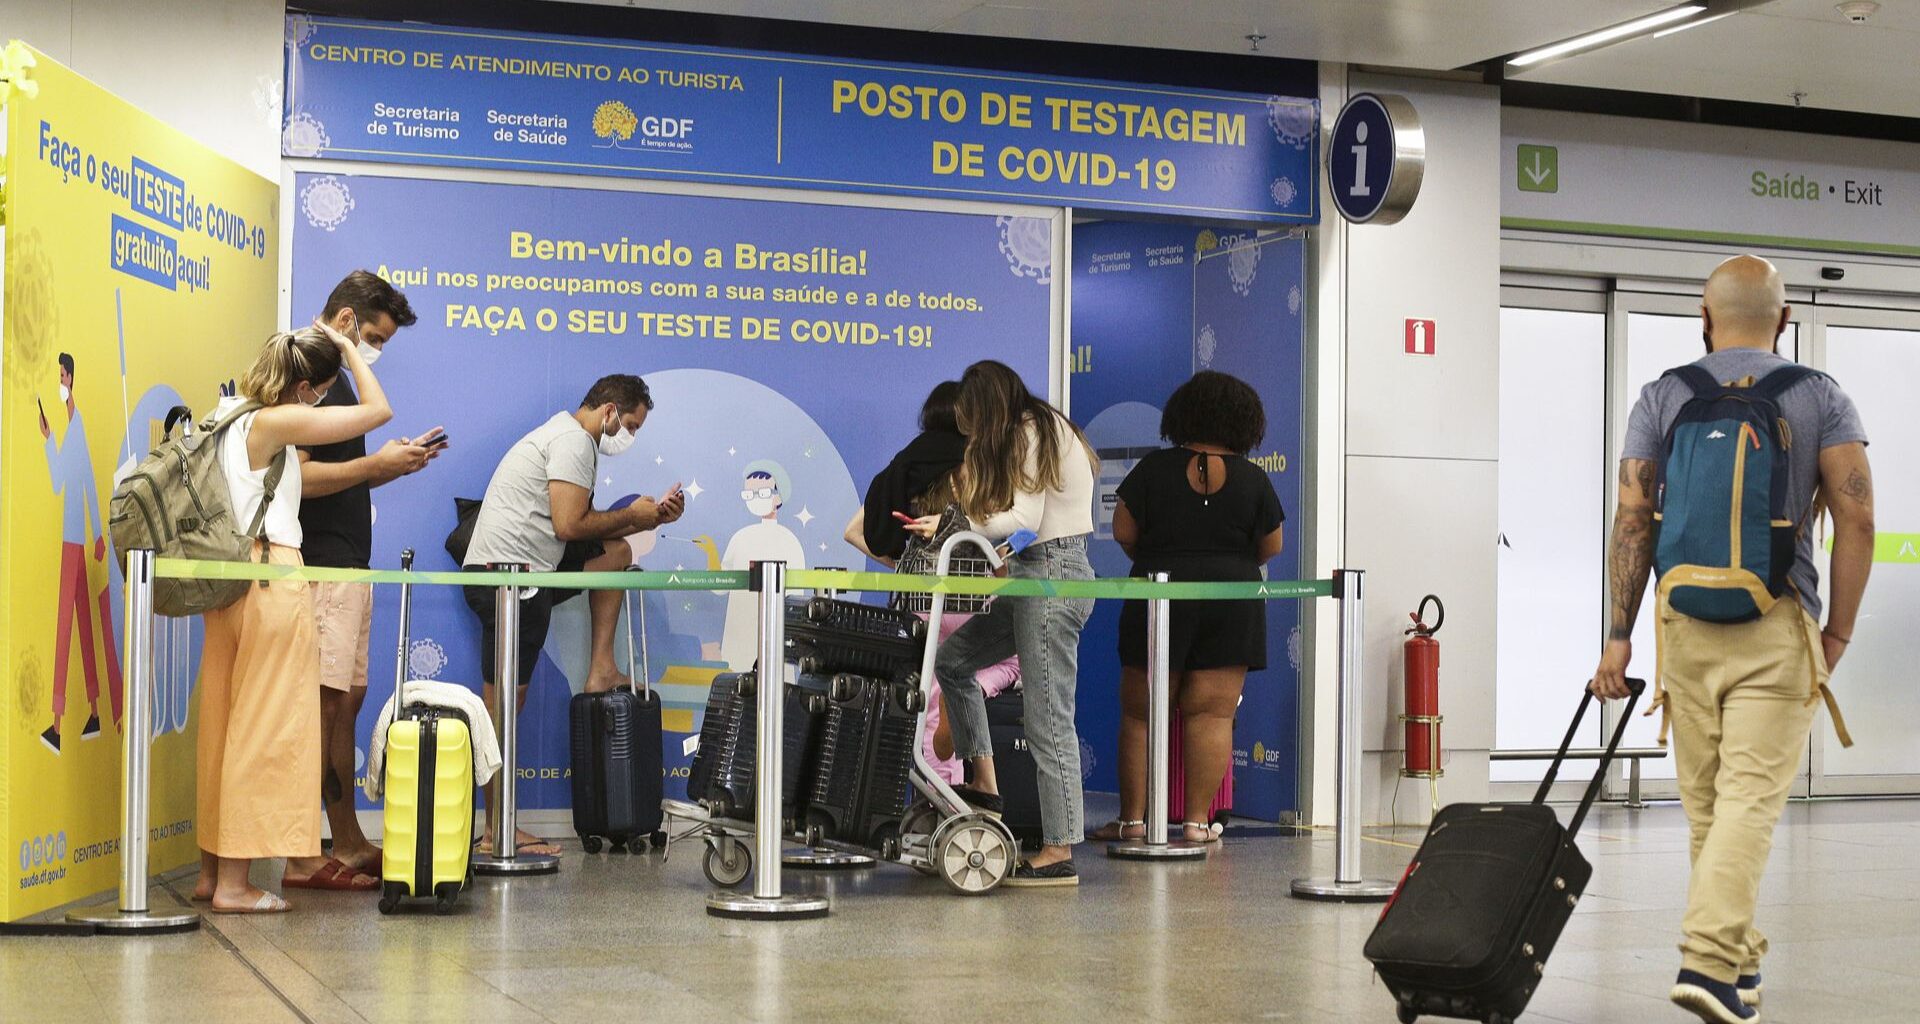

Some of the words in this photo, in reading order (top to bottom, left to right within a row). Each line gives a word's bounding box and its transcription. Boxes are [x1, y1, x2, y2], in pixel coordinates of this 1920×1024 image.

[310, 43, 406, 66] CENTRO
[414, 51, 442, 69] DE
[450, 54, 612, 82] ATENDIMENTO
[618, 67, 650, 84] AO
[656, 69, 744, 91] TURISTA
[374, 103, 460, 122] Secretaria
[487, 110, 568, 129] Secretaria
[832, 79, 968, 124] POSTO
[981, 92, 1033, 130] DE
[1044, 97, 1246, 147] TESTAGEM
[367, 120, 389, 136] de
[392, 121, 460, 140] Turismo
[493, 126, 514, 143] de
[517, 126, 567, 146] Saúde
[641, 116, 694, 139] GDF
[647, 140, 666, 148] tempo
[932, 141, 985, 177] DE
[998, 146, 1177, 192] COVID-19
[39, 119, 81, 184] Faça
[87, 154, 96, 184] o
[101, 161, 129, 200] seu
[134, 165, 182, 225] TESTE
[187, 194, 203, 232] de
[206, 202, 265, 260] COVID-19
[1751, 170, 1820, 201] Saída
[1845, 180, 1882, 206] Exit
[115, 228, 174, 278] gratuito
[178, 254, 210, 294] aqui!
[509, 231, 694, 268] Bem-vindo
[704, 247, 723, 269] a
[735, 243, 868, 277] Brasília!
[1092, 250, 1131, 264] Secretaria
[1146, 244, 1184, 257] Secretaria
[1089, 265, 1098, 275] de
[1101, 262, 1131, 274] Turismo
[1148, 257, 1158, 267] de
[376, 264, 429, 289] Aqui
[436, 270, 478, 287] nos
[486, 270, 643, 296] preocupamos
[650, 280, 698, 298] com
[705, 284, 718, 299] a
[725, 285, 765, 301] sua
[772, 284, 838, 305] saúde
[846, 291, 858, 306] e
[865, 292, 878, 307] a
[885, 290, 911, 308] de
[918, 292, 984, 312] todos.
[445, 304, 526, 336] FAÇA
[536, 308, 558, 332] O
[568, 309, 627, 335] SEU
[637, 312, 731, 339] TESTE
[741, 317, 781, 341] DE
[790, 319, 933, 348] COVID-19!
[1265, 749, 1280, 762] GDF
[540, 768, 559, 779] DE
[670, 767, 691, 778] AO
[73, 842, 102, 864] CENTRO
[103, 841, 113, 855] DE
[160, 826, 169, 839] AO
[169, 819, 193, 837] TURISTA
[20, 865, 66, 889] saude.df.gov.br
